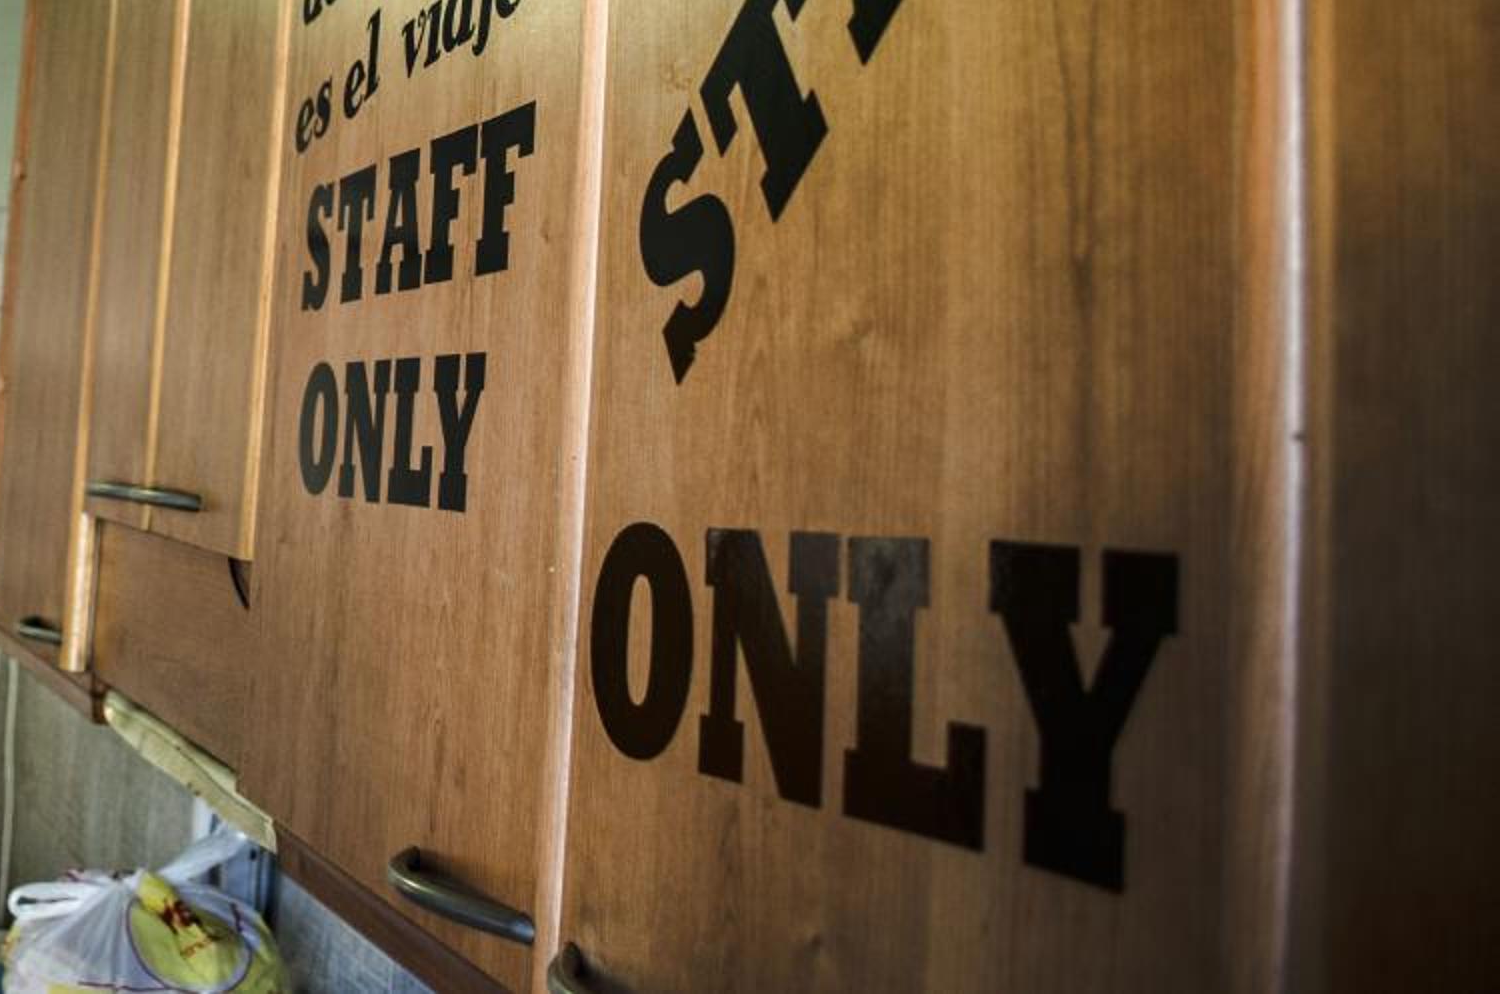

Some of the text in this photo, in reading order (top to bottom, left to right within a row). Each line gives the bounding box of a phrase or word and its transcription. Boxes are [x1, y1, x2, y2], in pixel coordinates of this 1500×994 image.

[295, 77, 333, 153] es
[343, 9, 381, 119] el
[301, 100, 537, 311] STAFF
[300, 352, 487, 513] ONLY
[591, 523, 1180, 894] ONLY
